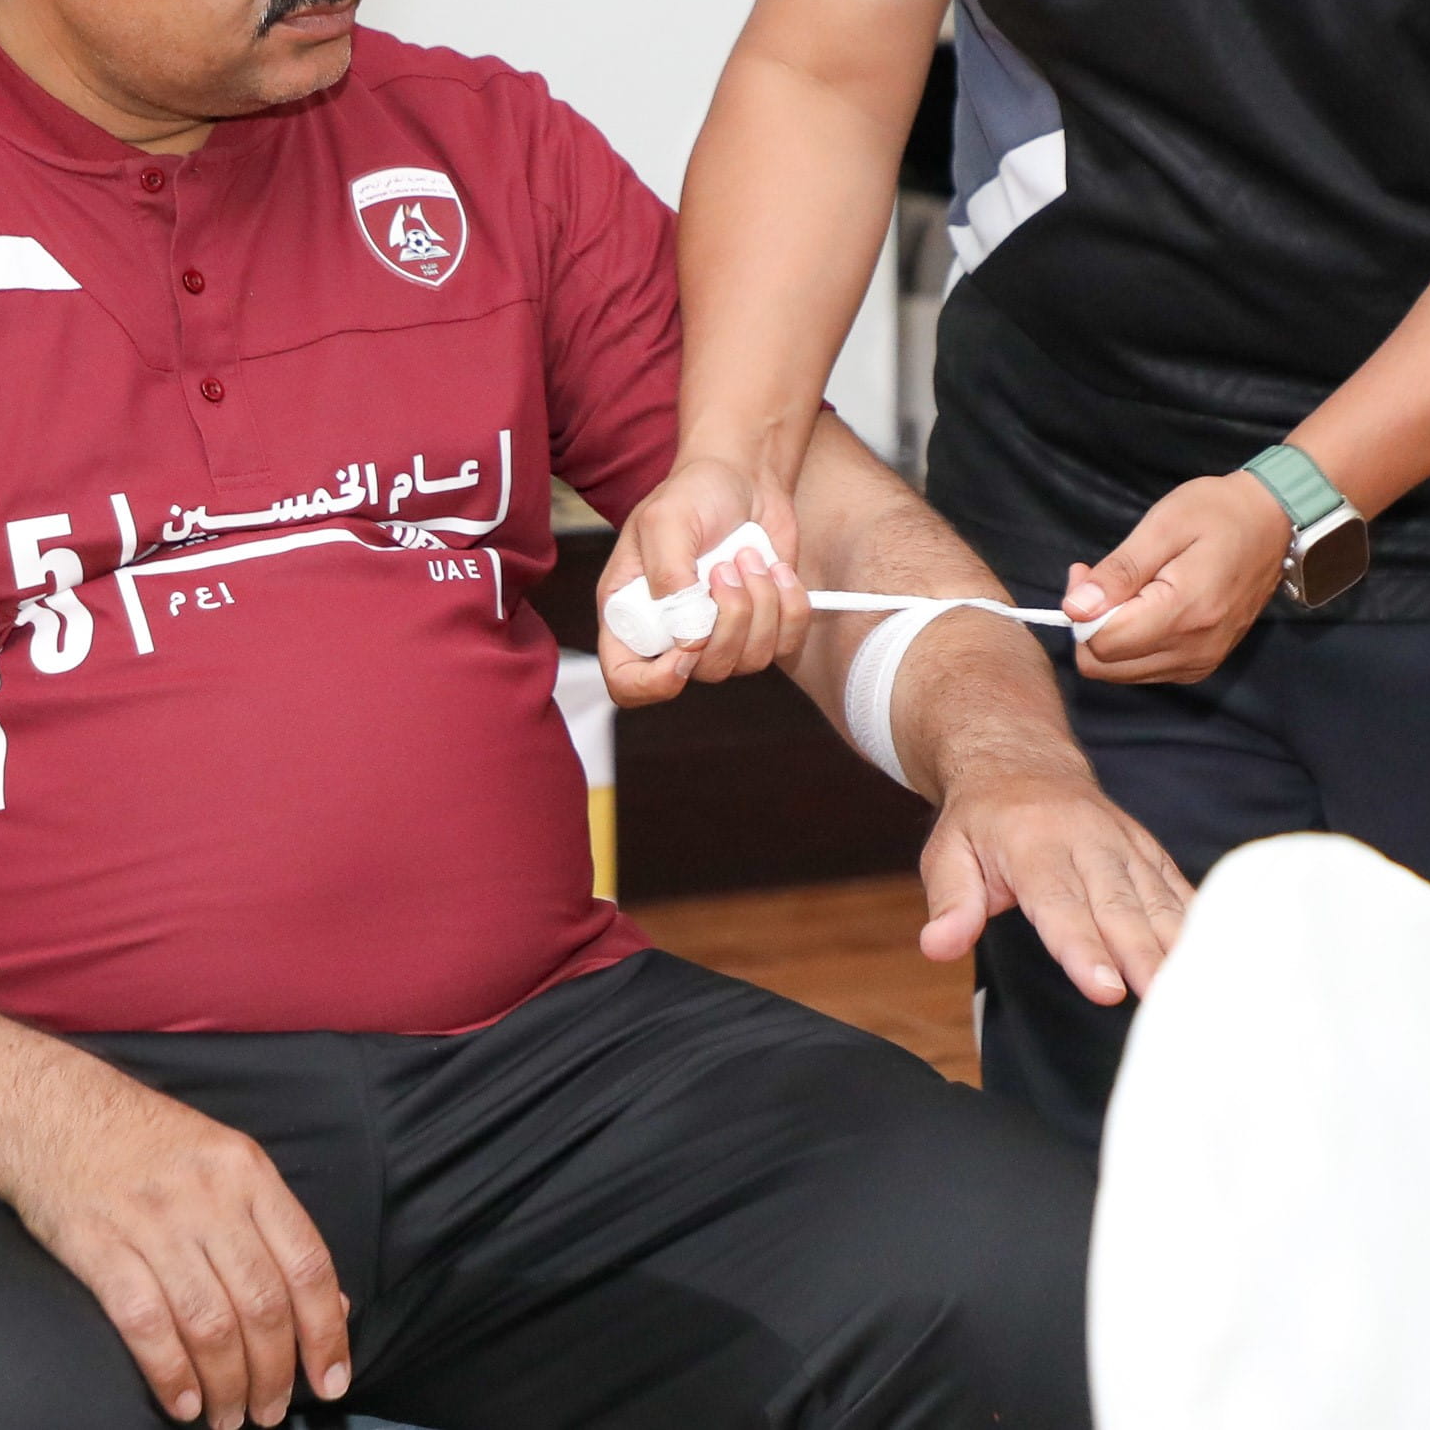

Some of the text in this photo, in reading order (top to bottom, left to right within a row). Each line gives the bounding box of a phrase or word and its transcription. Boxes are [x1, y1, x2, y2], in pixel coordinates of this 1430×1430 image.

[162, 453, 480, 542] عام الخمسين
[427, 558, 483, 582] UAE
